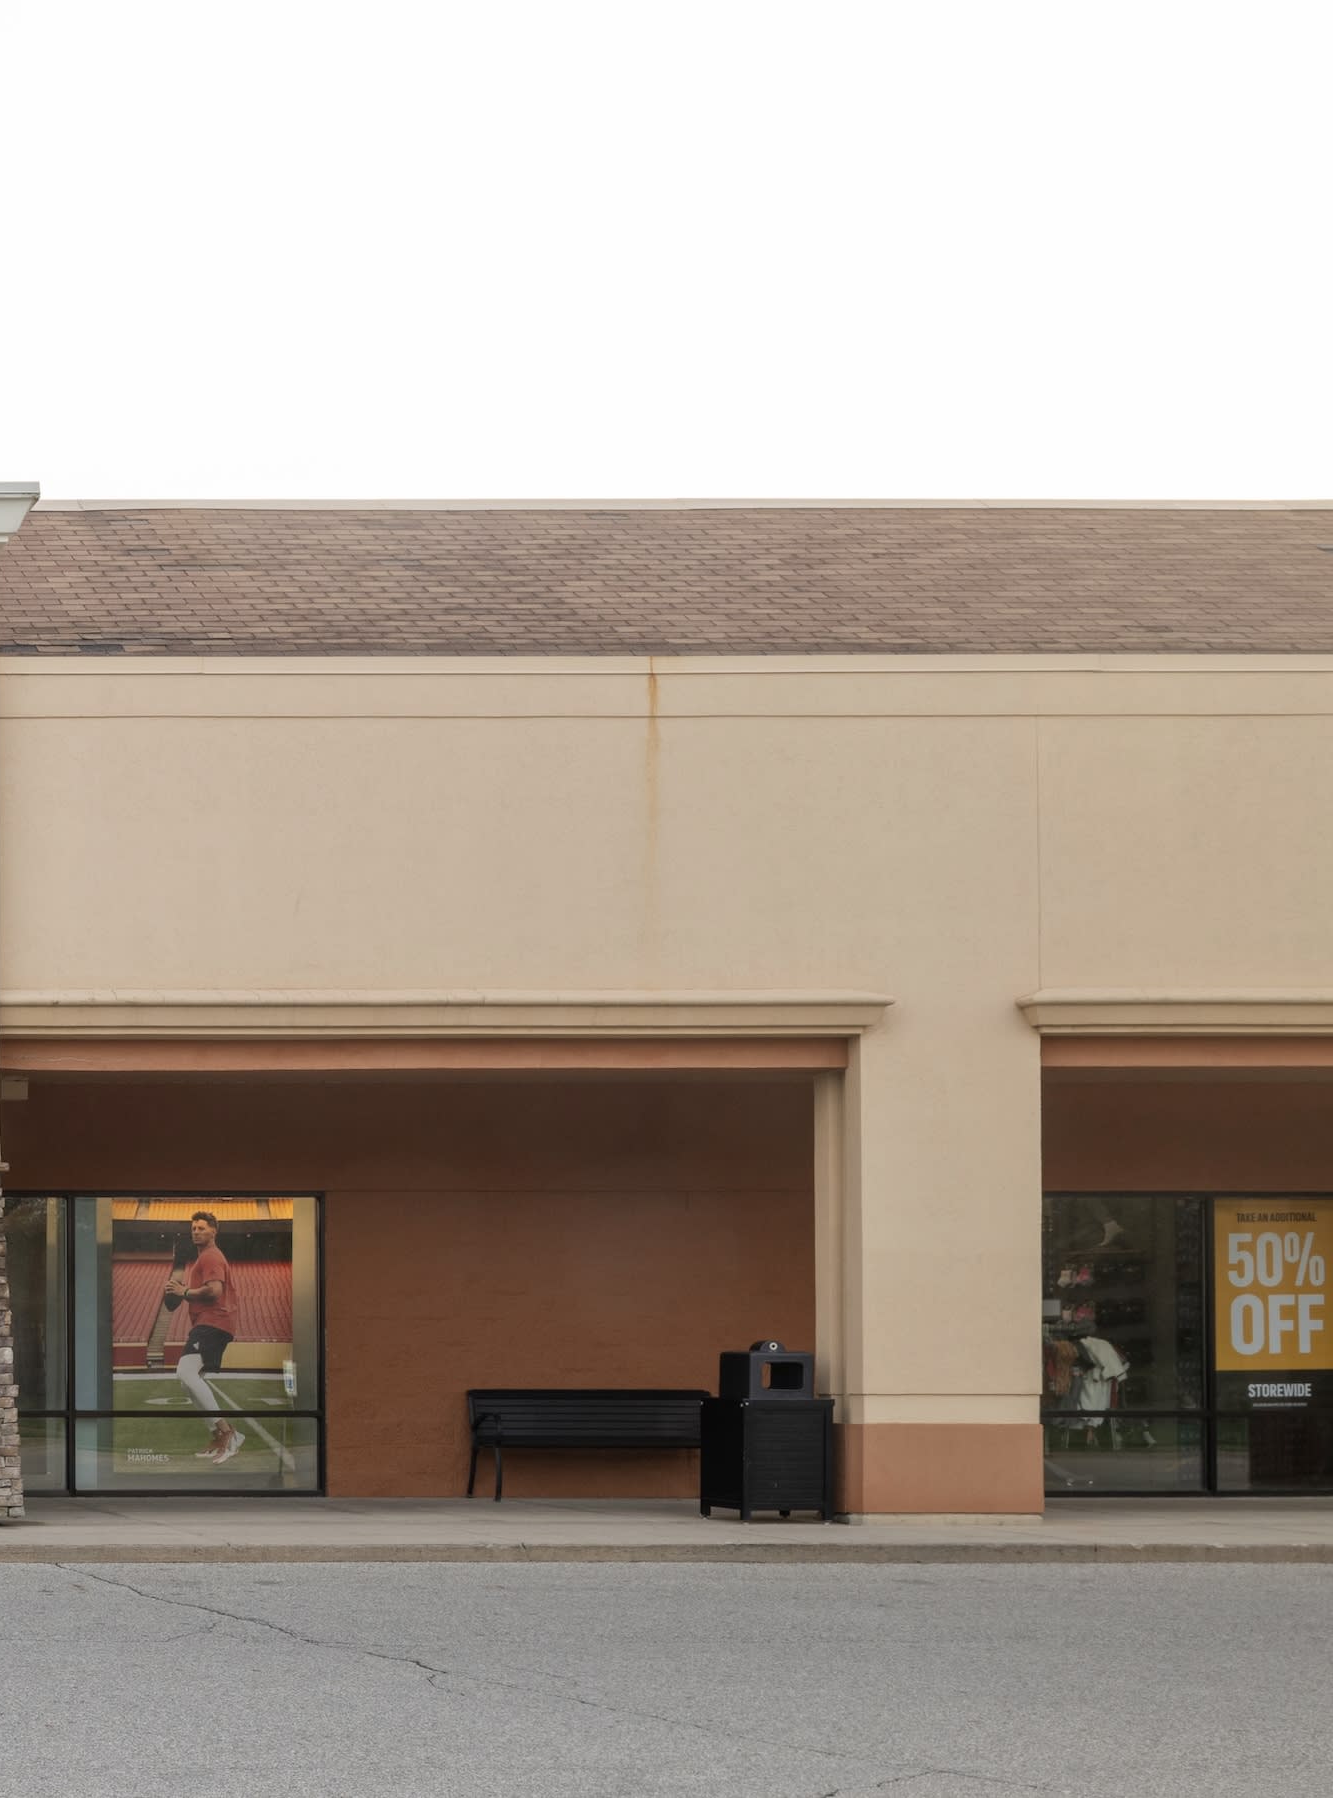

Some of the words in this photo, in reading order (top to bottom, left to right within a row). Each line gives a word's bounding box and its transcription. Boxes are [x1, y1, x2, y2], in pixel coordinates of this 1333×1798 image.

[1236, 1212, 1255, 1223] TAKE
[1257, 1212, 1269, 1223] AN
[1270, 1212, 1318, 1222] ADDITIONAL
[1227, 1232, 1326, 1287] 50%
[1230, 1294, 1325, 1355] OFF
[1248, 1383, 1312, 1397] STOREWIDE
[127, 1454, 170, 1462] MAHOMES
